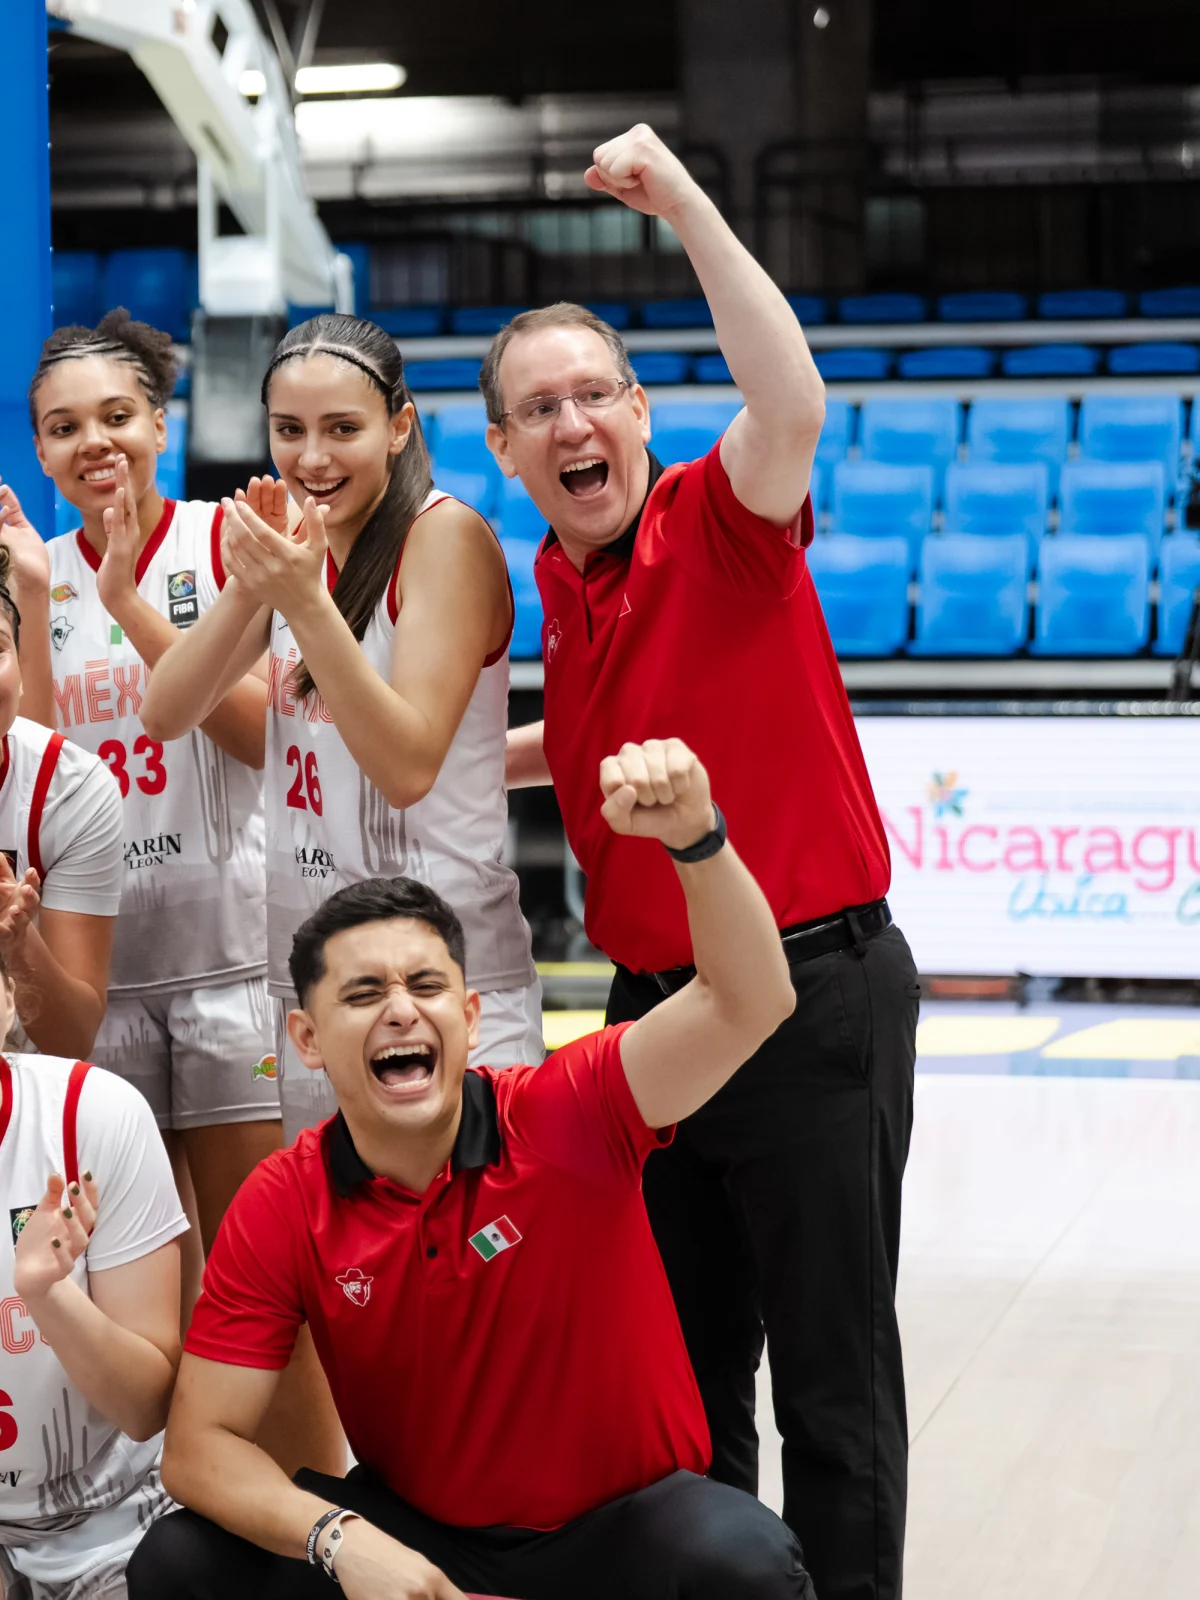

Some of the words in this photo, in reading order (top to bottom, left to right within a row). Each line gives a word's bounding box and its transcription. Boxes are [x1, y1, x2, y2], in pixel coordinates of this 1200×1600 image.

[173, 602, 194, 616] FIBA
[97, 734, 167, 799] 33
[286, 744, 323, 817] 26
[122, 832, 182, 861] ARÍN
[129, 853, 164, 870] LEÓN
[301, 866, 328, 879] EÓN
